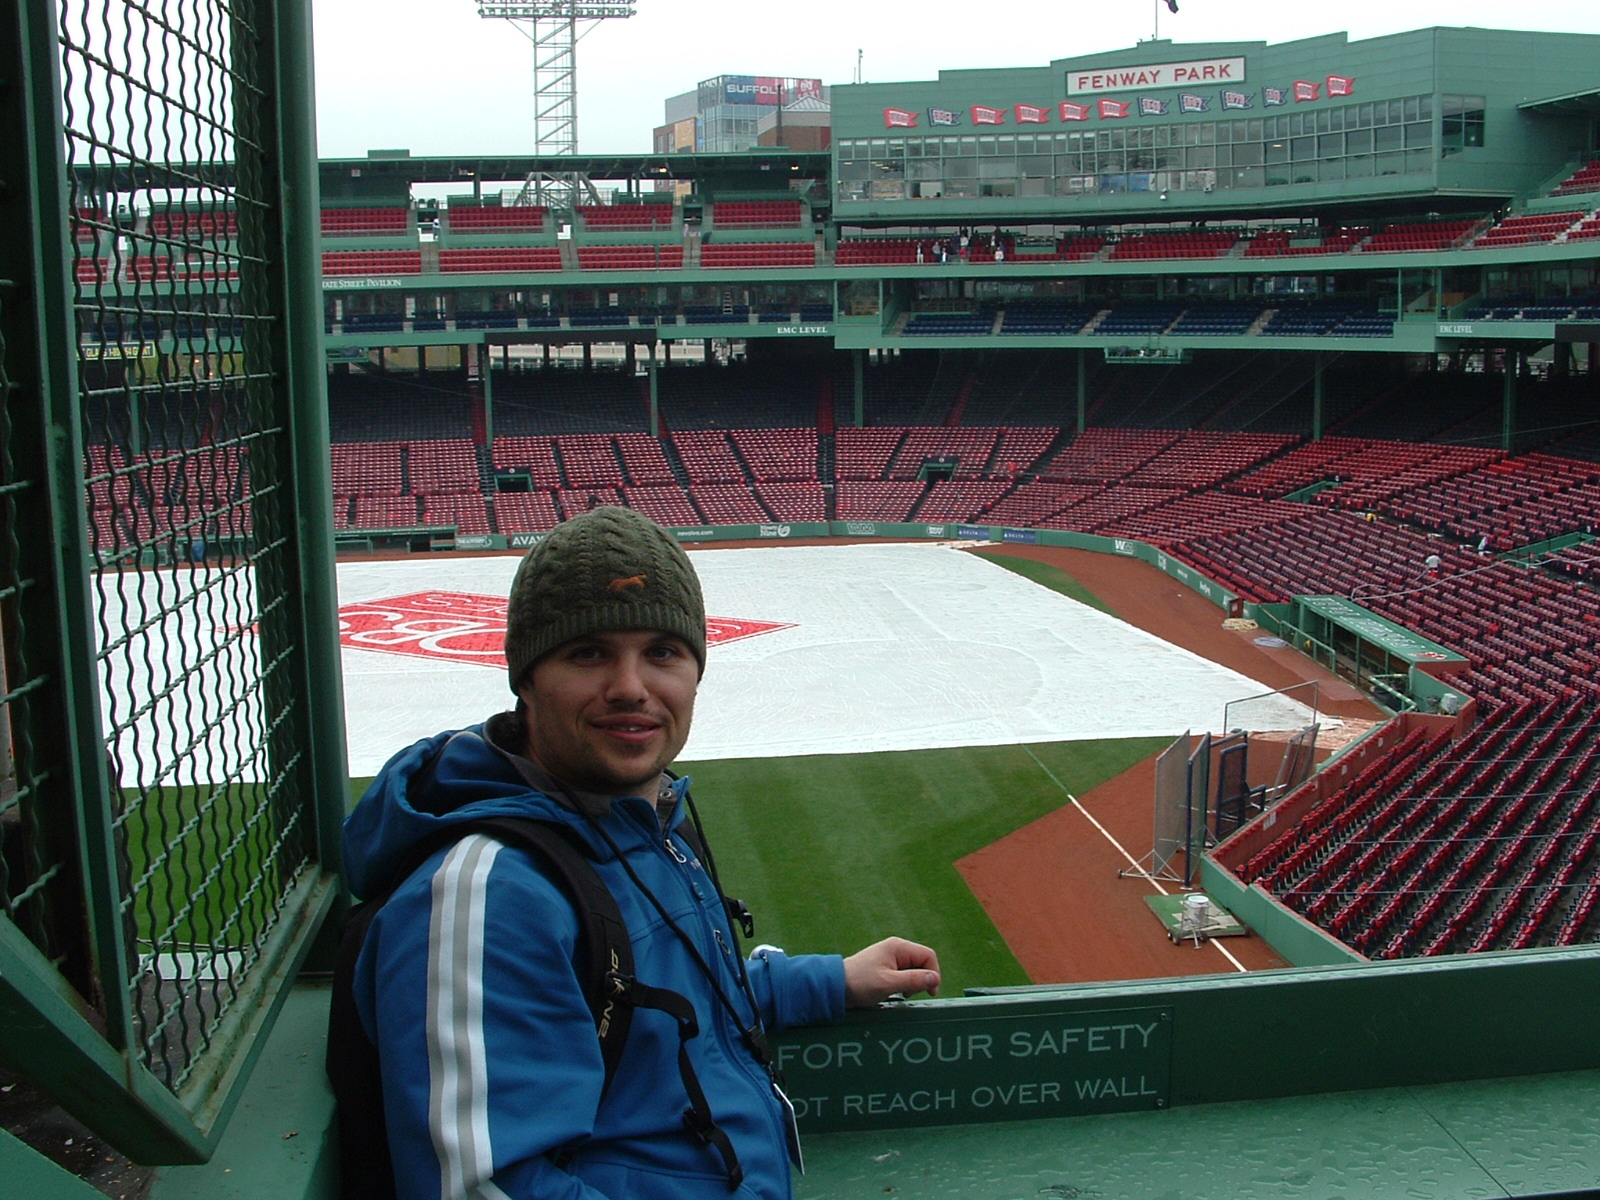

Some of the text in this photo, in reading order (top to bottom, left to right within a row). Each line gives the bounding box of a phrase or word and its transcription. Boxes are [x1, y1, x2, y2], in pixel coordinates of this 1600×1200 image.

[1078, 64, 1231, 89] FENWAY PARK
[339, 280, 364, 288] STREET
[366, 278, 402, 287] PAVILION
[799, 326, 828, 334] LEVEL
[1453, 325, 1473, 333] LEVEL
[512, 535, 544, 546] AVAY
[777, 1022, 1157, 1070] FOR YOUR SAFETY
[791, 1075, 1157, 1119] OT REACH OVER WALL
